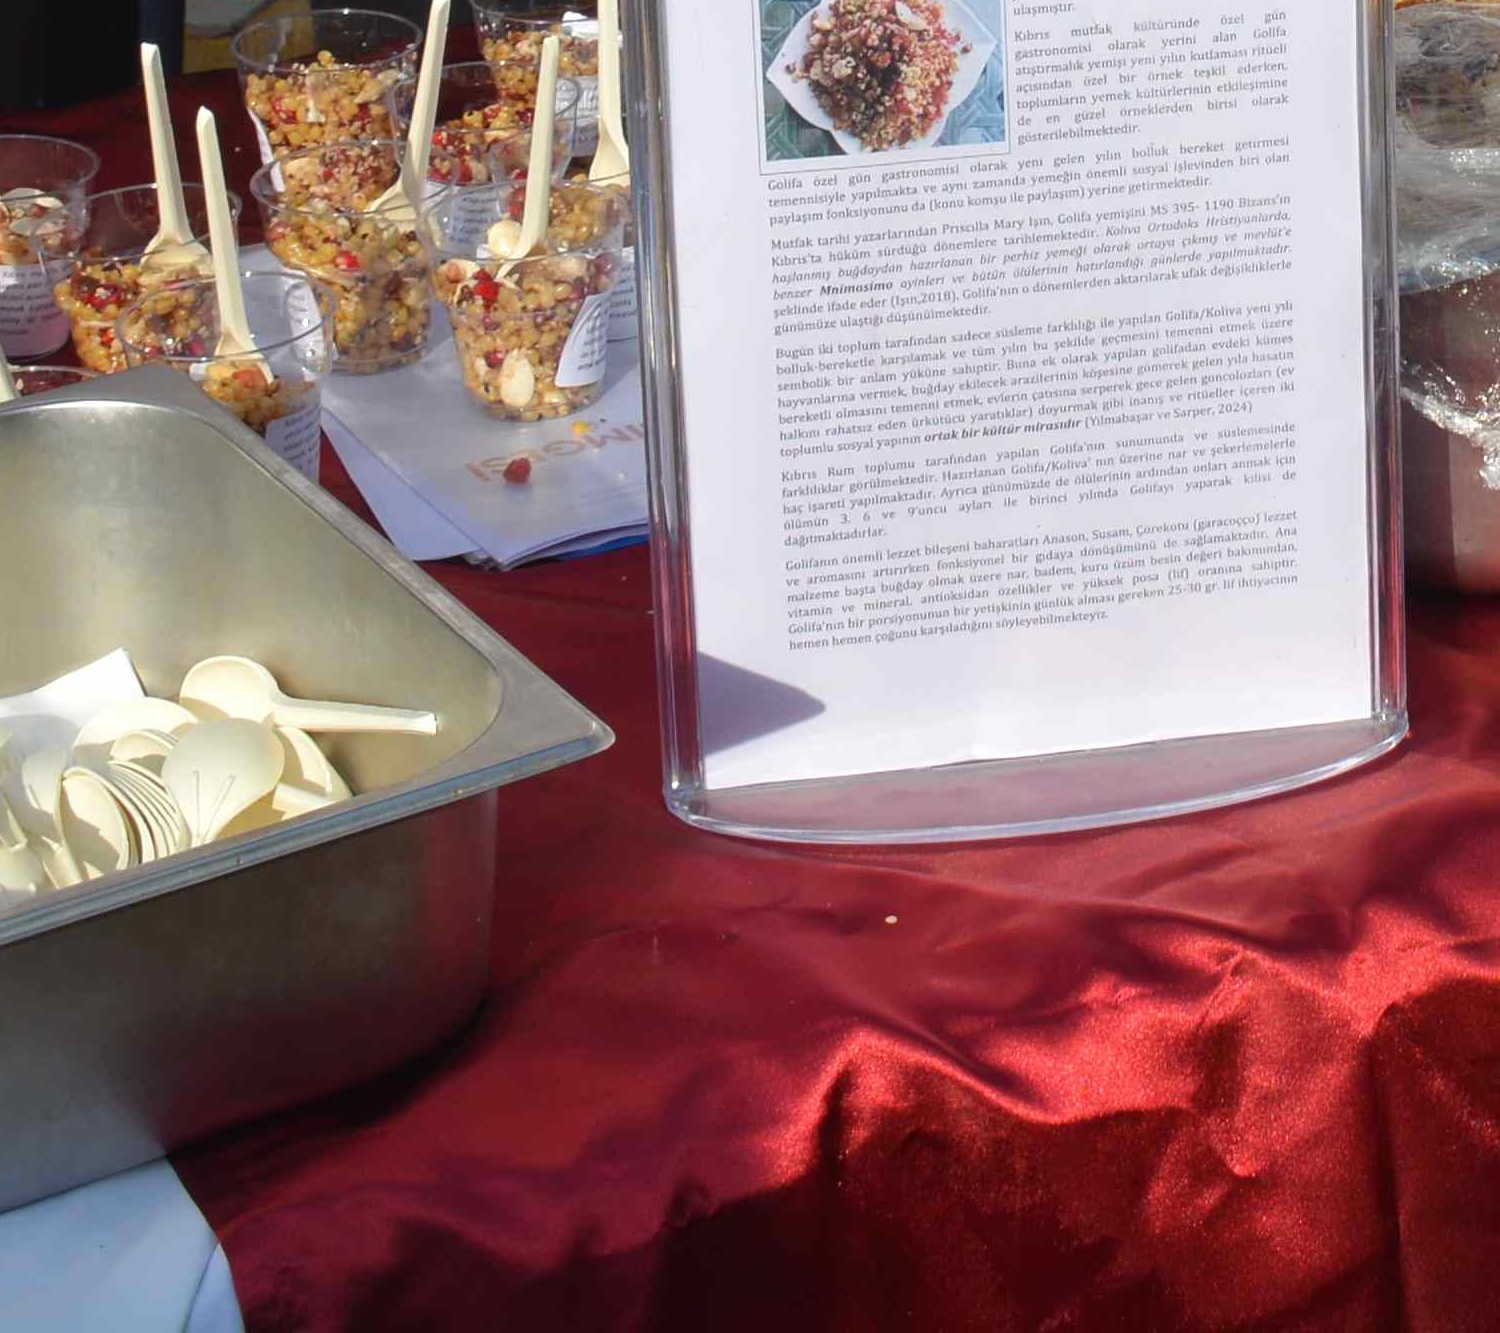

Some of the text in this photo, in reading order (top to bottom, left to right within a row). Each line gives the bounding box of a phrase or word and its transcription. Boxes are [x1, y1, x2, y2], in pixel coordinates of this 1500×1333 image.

[1012, 0, 1076, 17] ulaşmıştır.
[1014, 29, 1049, 41] Kıbrıs
[1070, 23, 1112, 36] mutfak
[1264, 10, 1286, 23] gün
[1014, 26, 1286, 60] gastronomisi olarak yerini alan Golifa
[1087, 56, 1126, 71] yemişi
[1130, 54, 1156, 68] yeni
[1159, 51, 1186, 65] yılın
[1189, 47, 1248, 60] kutlaması
[1016, 78, 1072, 94] açısından
[1118, 72, 1136, 83] bir
[1194, 65, 1226, 79] teşkil
[1017, 93, 1086, 111] toplumların
[1091, 89, 1131, 104] yemek
[1216, 77, 1288, 94] etkileşimine
[1017, 115, 1031, 125] de
[1046, 115, 1060, 123] en
[1206, 98, 1237, 109] birisi
[1251, 93, 1289, 105] olarak
[1018, 123, 1141, 144] gösterilebilmektedir.
[768, 177, 803, 189] Golifa
[848, 172, 871, 186] gün
[881, 164, 959, 182] gastronomisi
[970, 159, 1008, 172] olarak
[1017, 157, 1043, 170] yeni
[1053, 152, 1085, 167] gelen
[1094, 149, 1121, 163] yılın
[1131, 145, 1169, 157] bolluk
[1179, 141, 1224, 154] bereket
[1235, 136, 1289, 152] getirmesi
[767, 191, 846, 209] temennisiyle
[851, 185, 917, 202] yapılmakta
[922, 185, 936, 193] ve
[942, 182, 967, 193] aynı
[973, 175, 1025, 188] zamanda
[1030, 170, 1081, 186] yemeğin
[1132, 162, 1168, 177] sosyal
[1238, 154, 1259, 165] biri
[1265, 151, 1290, 163] olan
[769, 210, 823, 226] paylaşım
[825, 202, 909, 221] fonksiyonunu
[911, 200, 925, 211] da
[929, 197, 964, 211] (konu
[1009, 191, 1024, 202] ile
[1027, 186, 1084, 203] paylaşım)
[1087, 183, 1125, 198] yerine
[1128, 175, 1212, 193] getirmektedir.
[769, 236, 813, 249] Mutfak
[817, 233, 850, 245] tarihi
[854, 225, 937, 244] yazarlarından
[992, 217, 1024, 231] Mary
[1058, 211, 1091, 223] Golifa
[1095, 207, 1146, 222] yemişini
[1205, 199, 1234, 210] 1190
[933, 236, 996, 251] dönemlere
[1002, 227, 1099, 244] tarihlemektedir.
[1147, 218, 1199, 231] Ortodoks
[774, 304, 992, 335] günümüze ulaştığı düşünülmektedir.
[780, 442, 834, 459] toplumlu
[837, 438, 874, 453] sosyal
[876, 436, 921, 449] yapının
[924, 429, 958, 441] ortak
[961, 427, 980, 438] bir
[982, 423, 1021, 436] kültür
[1218, 401, 1252, 415] 2024)
[781, 468, 816, 481] Kıbrıs
[827, 465, 854, 476] Rum
[864, 458, 915, 475] toplumu
[925, 451, 986, 466] tarafından
[996, 446, 1040, 462] yapılan
[1116, 432, 1183, 447] sunumunda
[1193, 432, 1207, 440] ve
[784, 526, 886, 547] dağıtmaktadırlar.
[788, 636, 829, 649] hemen
[831, 632, 872, 645] hemen
[875, 627, 917, 643] çoğunu
